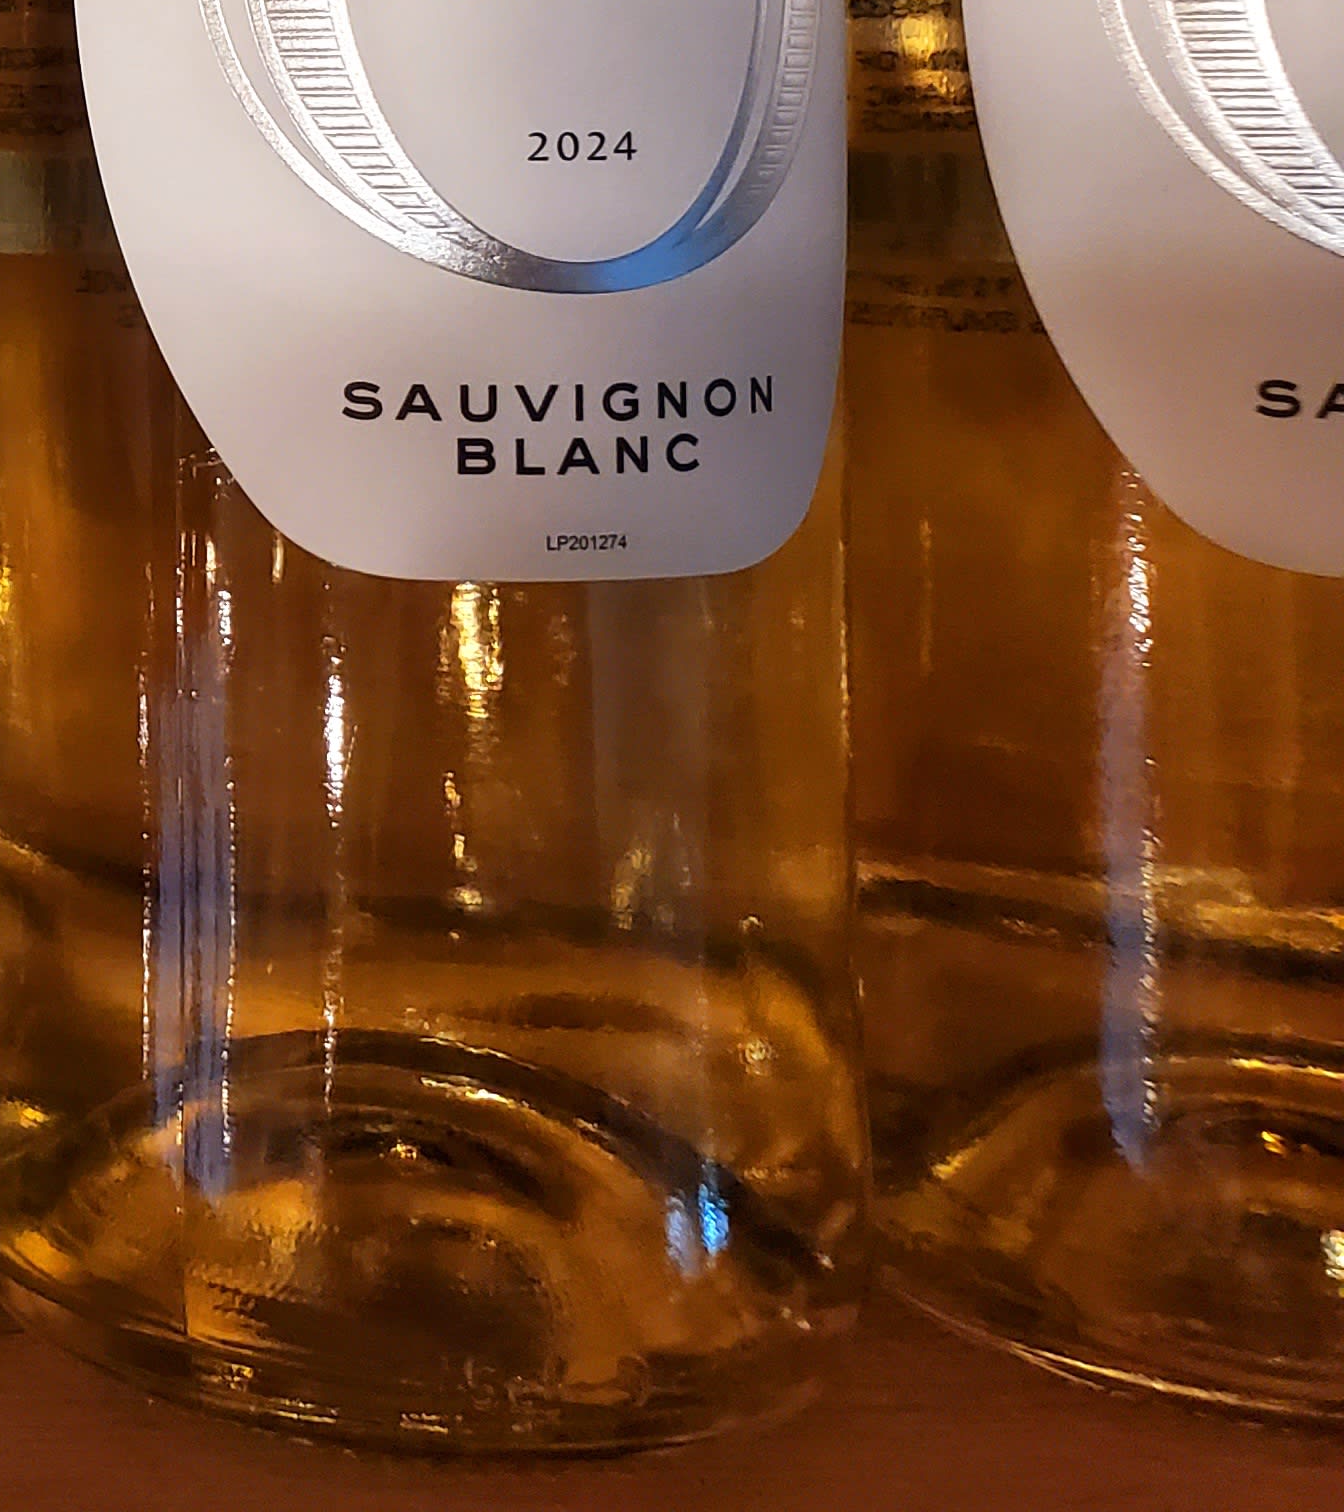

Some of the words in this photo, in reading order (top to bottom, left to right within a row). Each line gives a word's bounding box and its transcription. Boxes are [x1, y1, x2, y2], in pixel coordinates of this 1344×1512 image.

[527, 130, 638, 162] 2024
[342, 375, 773, 423] SAUVIGNON
[457, 432, 700, 476] BLANC
[545, 533, 628, 552] LP201274
